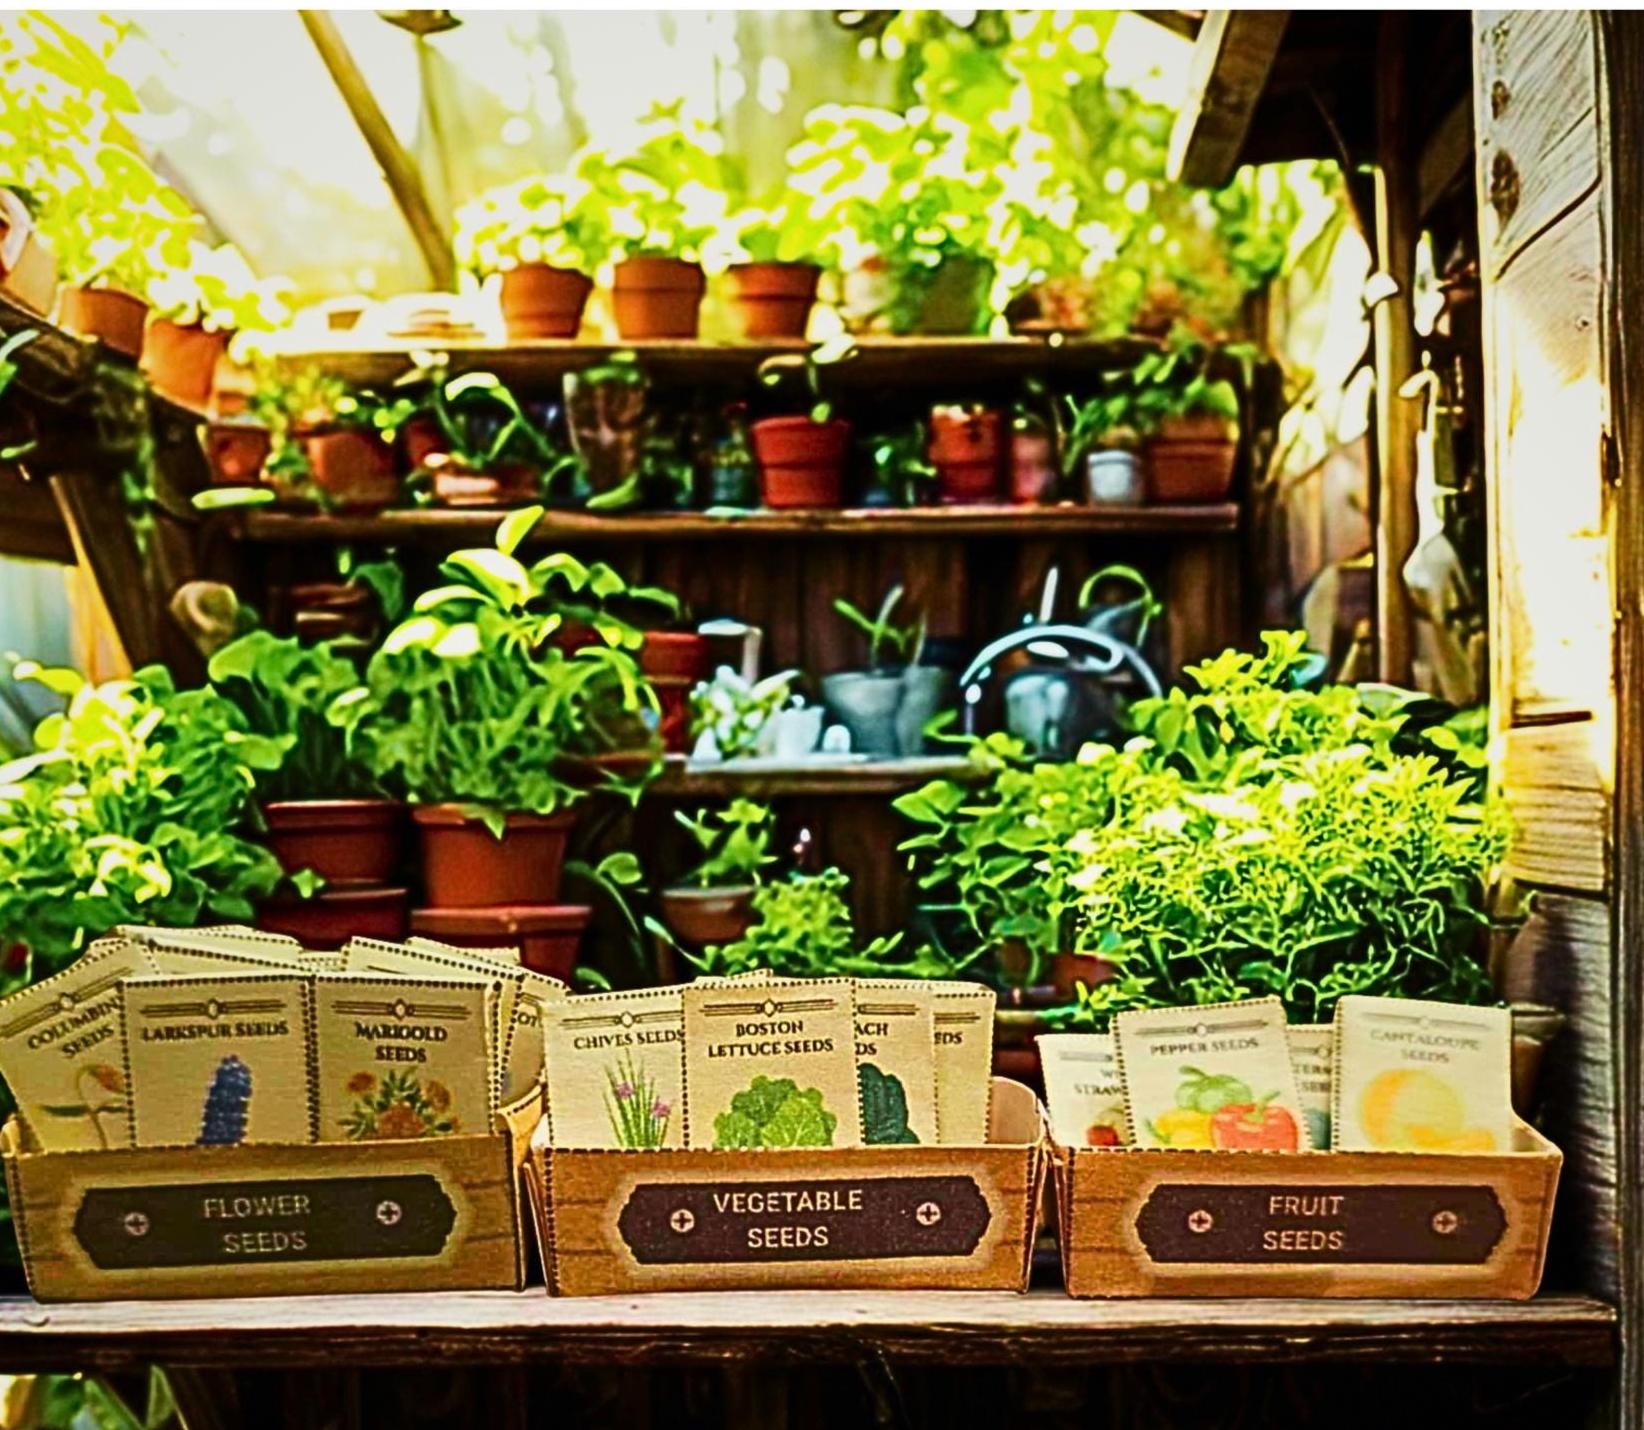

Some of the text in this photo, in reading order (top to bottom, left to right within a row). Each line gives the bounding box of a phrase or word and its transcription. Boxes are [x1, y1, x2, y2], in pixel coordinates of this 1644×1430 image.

[141, 1020, 289, 1042] LARKSPUR SEEDS
[354, 1021, 448, 1043] MARIGOLD
[736, 1020, 804, 1037] BOSTON
[61, 1024, 114, 1059] SEEDS
[573, 1029, 685, 1050] CHIVES SEEDS
[707, 1038, 834, 1058] LETTUCE SEEDS
[1150, 1036, 1260, 1056] PEPPER SEEDS
[1370, 1028, 1480, 1051] CANTALOUPE
[375, 1045, 427, 1063] SEEDS
[1400, 1048, 1450, 1063] SEEDS
[203, 1194, 311, 1219] FLOWER
[713, 1189, 863, 1213] VEGETABLE
[1268, 1196, 1345, 1216] FRUIT
[222, 1232, 308, 1254] SEEDS
[746, 1226, 829, 1248] SEEDS
[1262, 1231, 1344, 1251] SEEDS
